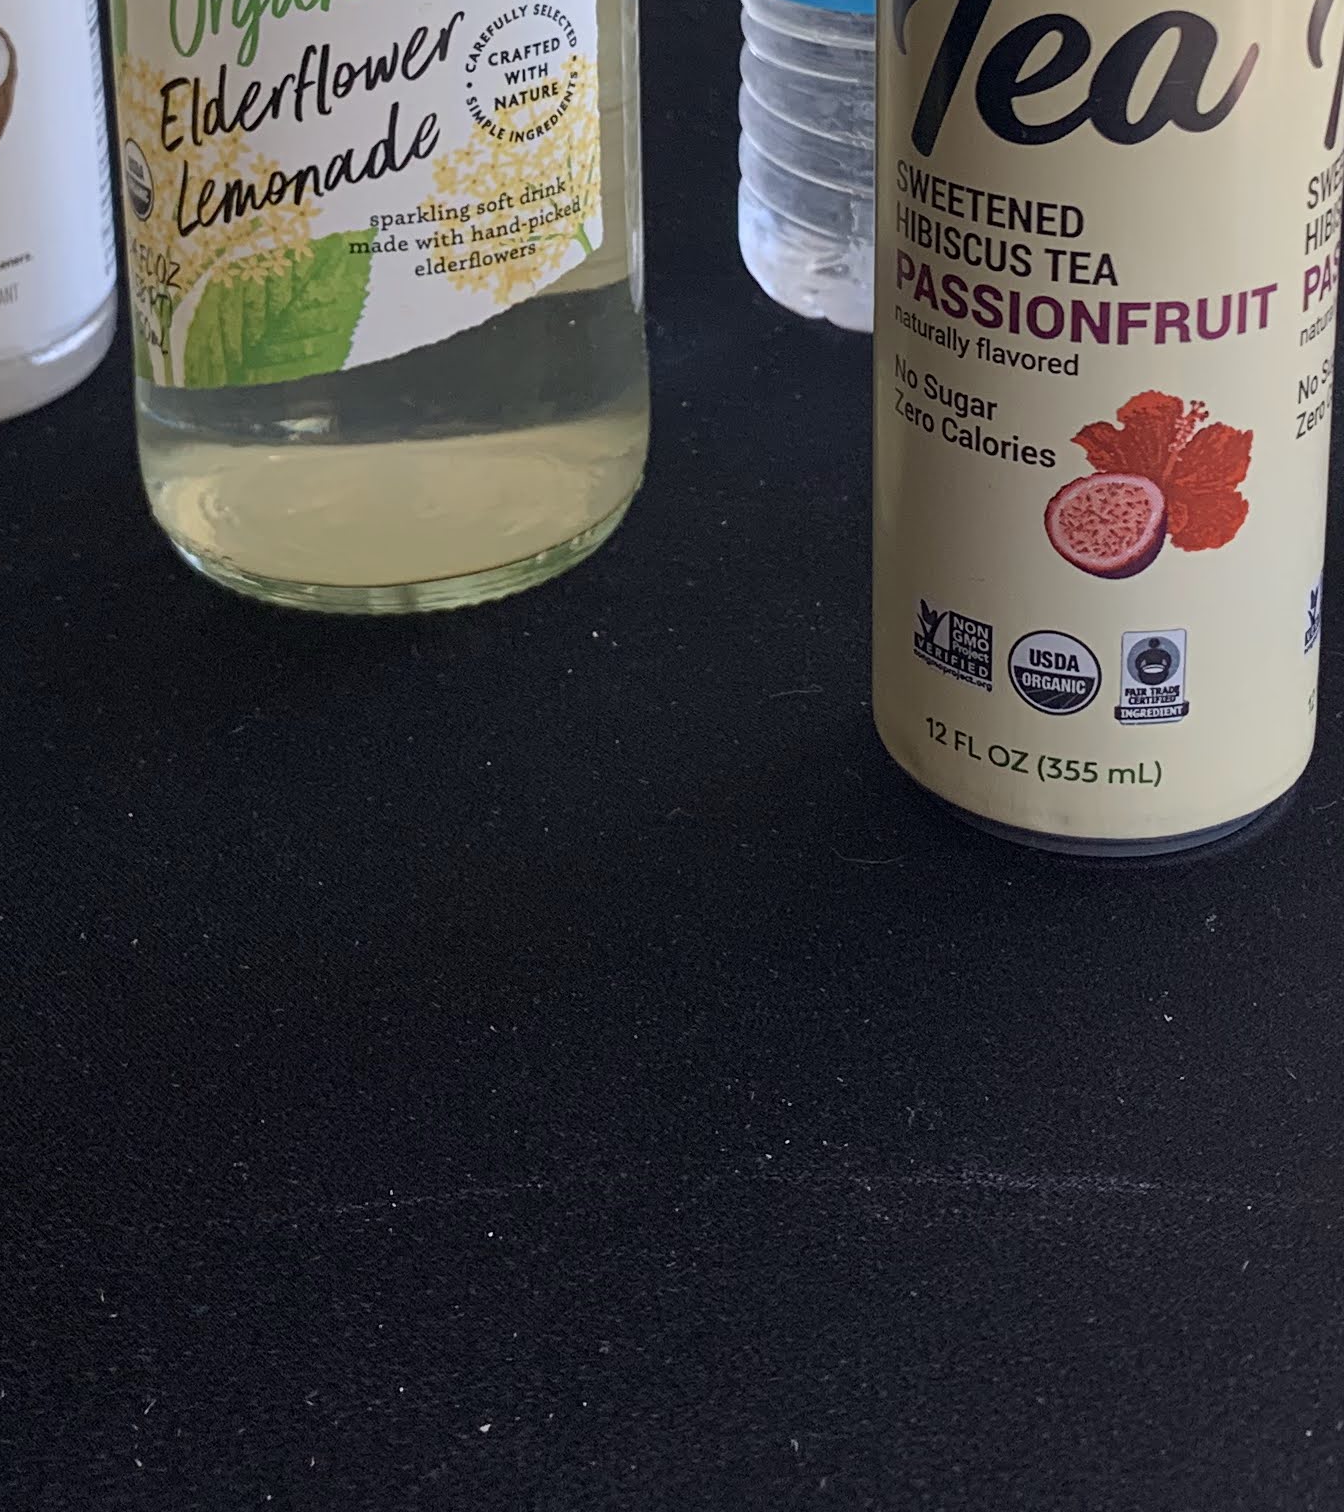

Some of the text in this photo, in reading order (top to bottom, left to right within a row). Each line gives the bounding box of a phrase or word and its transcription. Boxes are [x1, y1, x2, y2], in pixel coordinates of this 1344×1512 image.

[465, 4, 578, 73] CAREFULLY SELECTED
[487, 38, 560, 66] CRAFTED
[159, 11, 464, 152] Elderflower
[505, 63, 549, 85] WITH
[466, 71, 579, 143] SIMPLE INGREDIENTS
[494, 82, 559, 112] NATURE
[176, 101, 441, 237] Lemonade
[369, 177, 566, 232] sparkling soft drink
[896, 160, 1084, 239] SWEETENED
[348, 196, 581, 254] made with hand-picked
[896, 203, 1118, 286] HIBISCUS TEA
[414, 242, 536, 276] elderflowers
[896, 250, 1278, 346] PASSIONFRUIT
[895, 305, 1079, 376] naturally flavored
[894, 354, 997, 422] No Sugar
[1297, 374, 1319, 404] No
[894, 389, 1057, 468] Zero Calories
[1296, 399, 1326, 439] Zero
[952, 630, 990, 651] GMO
[953, 619, 989, 639] NON
[916, 640, 989, 678] VERIFIED
[952, 643, 989, 663] Project
[1029, 648, 1080, 672] USDA
[1022, 672, 1086, 695] ORGANIC
[1124, 686, 1180, 698] FAIR TRADE
[1128, 695, 1176, 705] CERTIFIED
[1120, 706, 1184, 718] INGREDIENT
[926, 717, 1162, 788] 12 FL OZ (355 mL)
